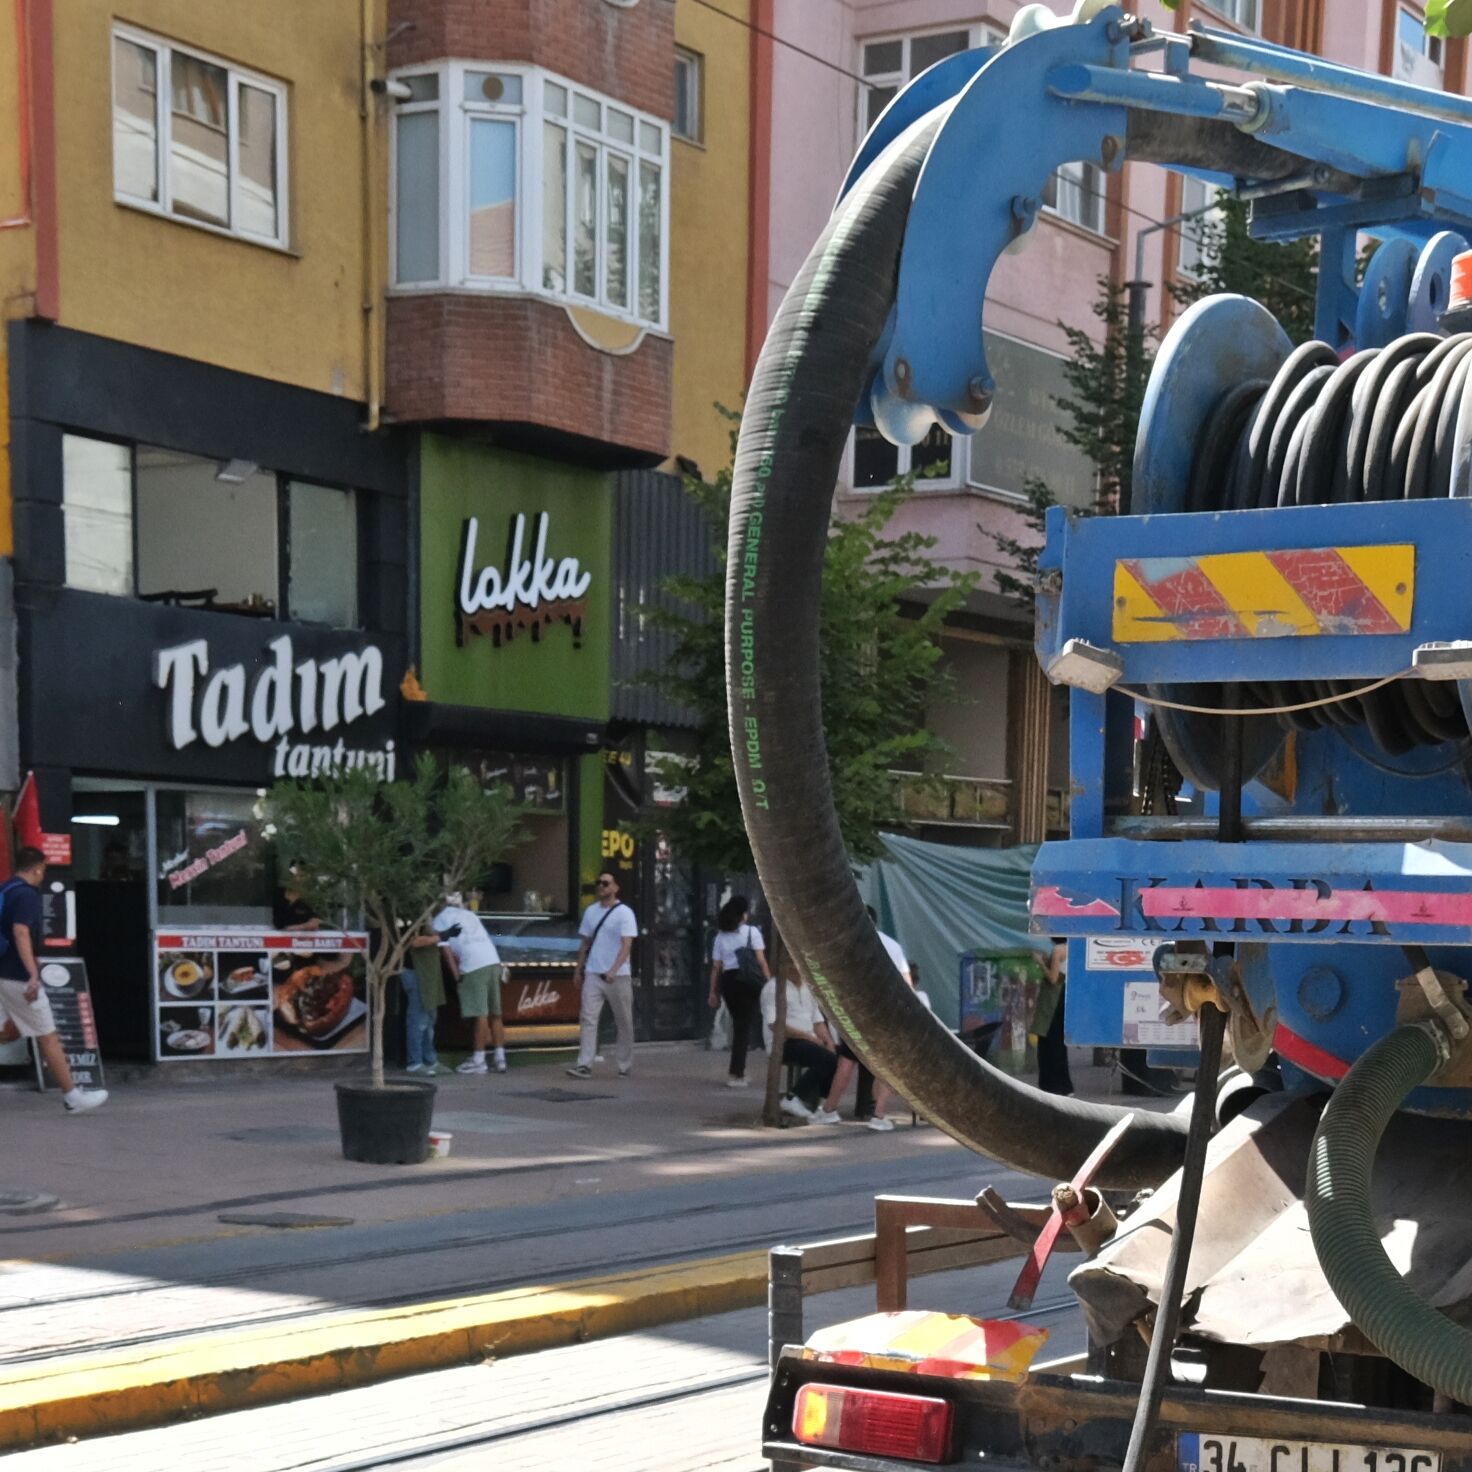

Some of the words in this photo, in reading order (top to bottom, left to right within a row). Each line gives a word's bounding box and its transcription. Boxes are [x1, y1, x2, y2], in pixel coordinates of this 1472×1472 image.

[740, 511, 764, 602] GENERAL
[158, 634, 386, 750] Tadım
[740, 608, 756, 700] PURPOSE
[743, 717, 763, 769] EPDM
